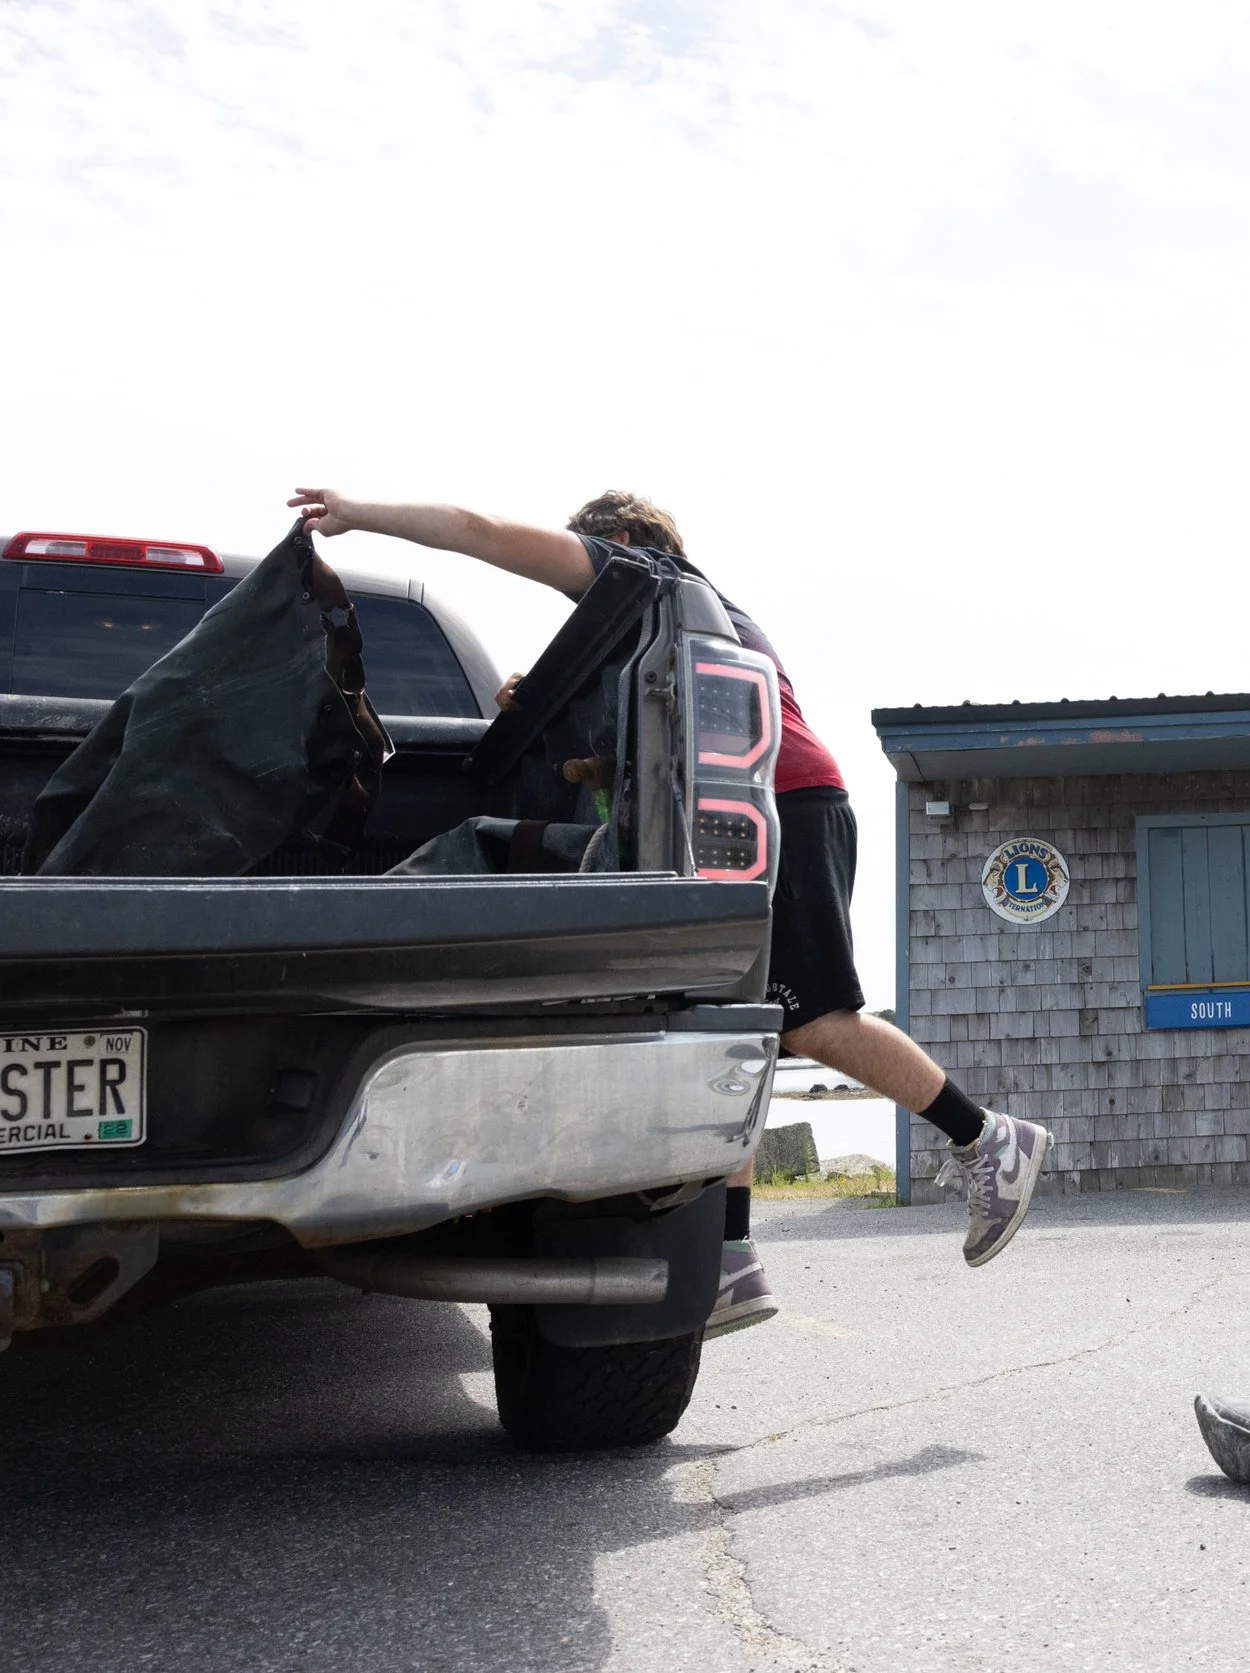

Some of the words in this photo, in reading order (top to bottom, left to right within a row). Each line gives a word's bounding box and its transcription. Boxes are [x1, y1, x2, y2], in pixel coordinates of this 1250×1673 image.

[1004, 842, 1049, 859] LIONS
[1015, 863, 1038, 893] L
[1190, 1002, 1232, 1019] SOUTH
[105, 1037, 132, 1051] NOV
[0, 1058, 127, 1122] STER
[103, 1123, 128, 1135] 22
